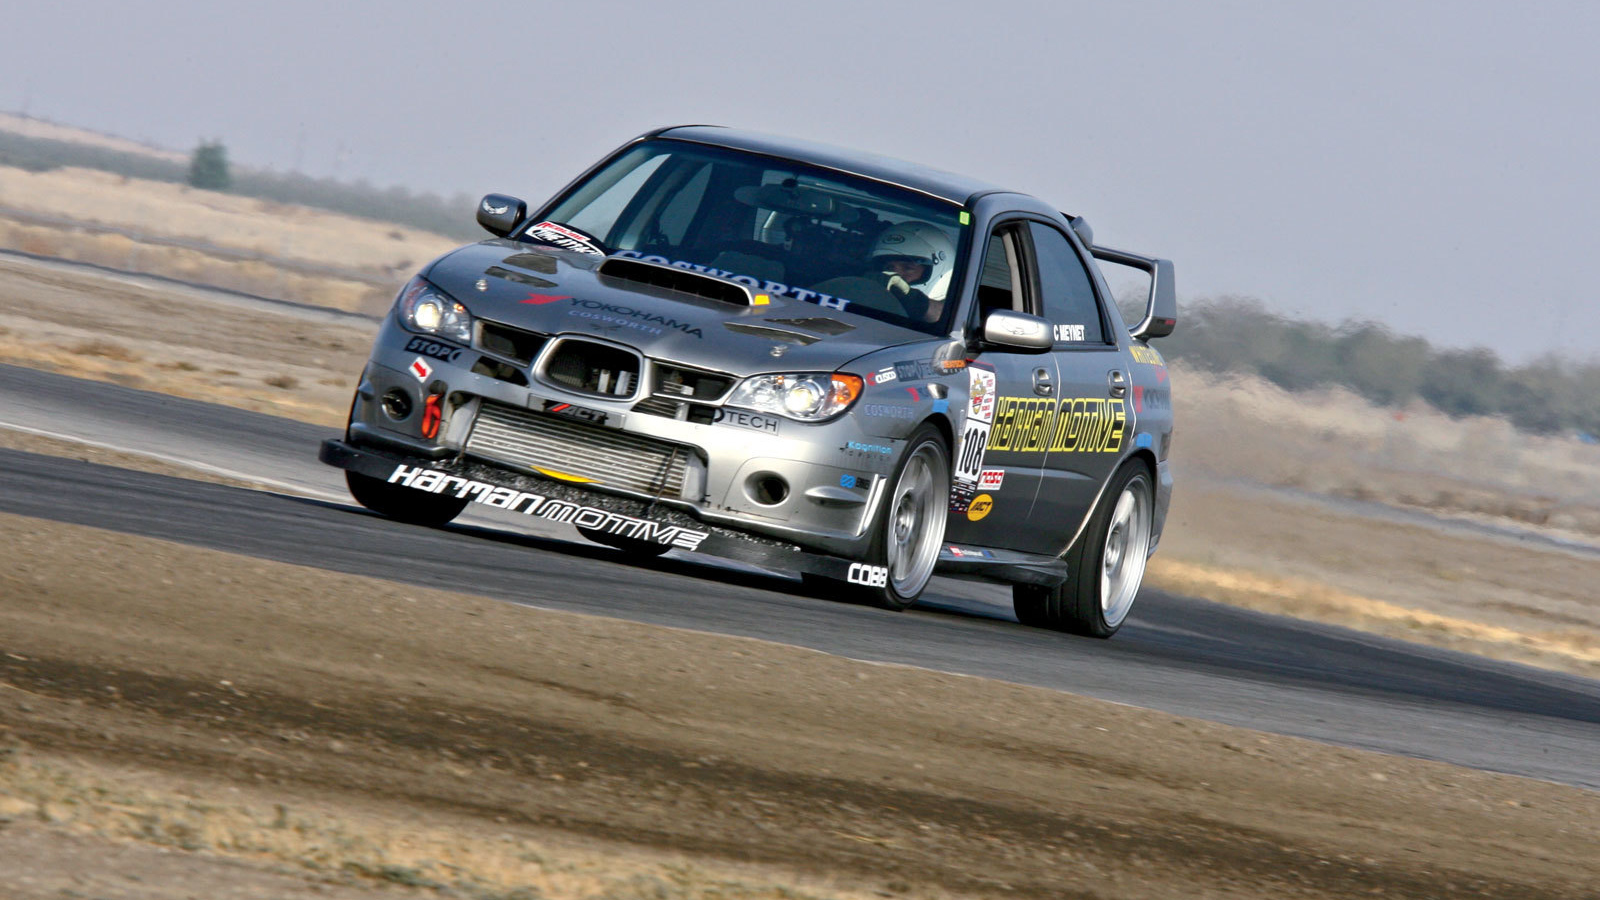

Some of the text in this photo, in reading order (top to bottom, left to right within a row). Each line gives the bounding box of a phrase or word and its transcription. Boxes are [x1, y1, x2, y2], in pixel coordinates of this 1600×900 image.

[568, 297, 704, 339] YOKOHAMA
[568, 310, 663, 335] COSWORTH
[1053, 324, 1059, 341] C
[726, 410, 778, 433] TECH
[958, 427, 987, 476] 108
[847, 562, 888, 588] COBB
